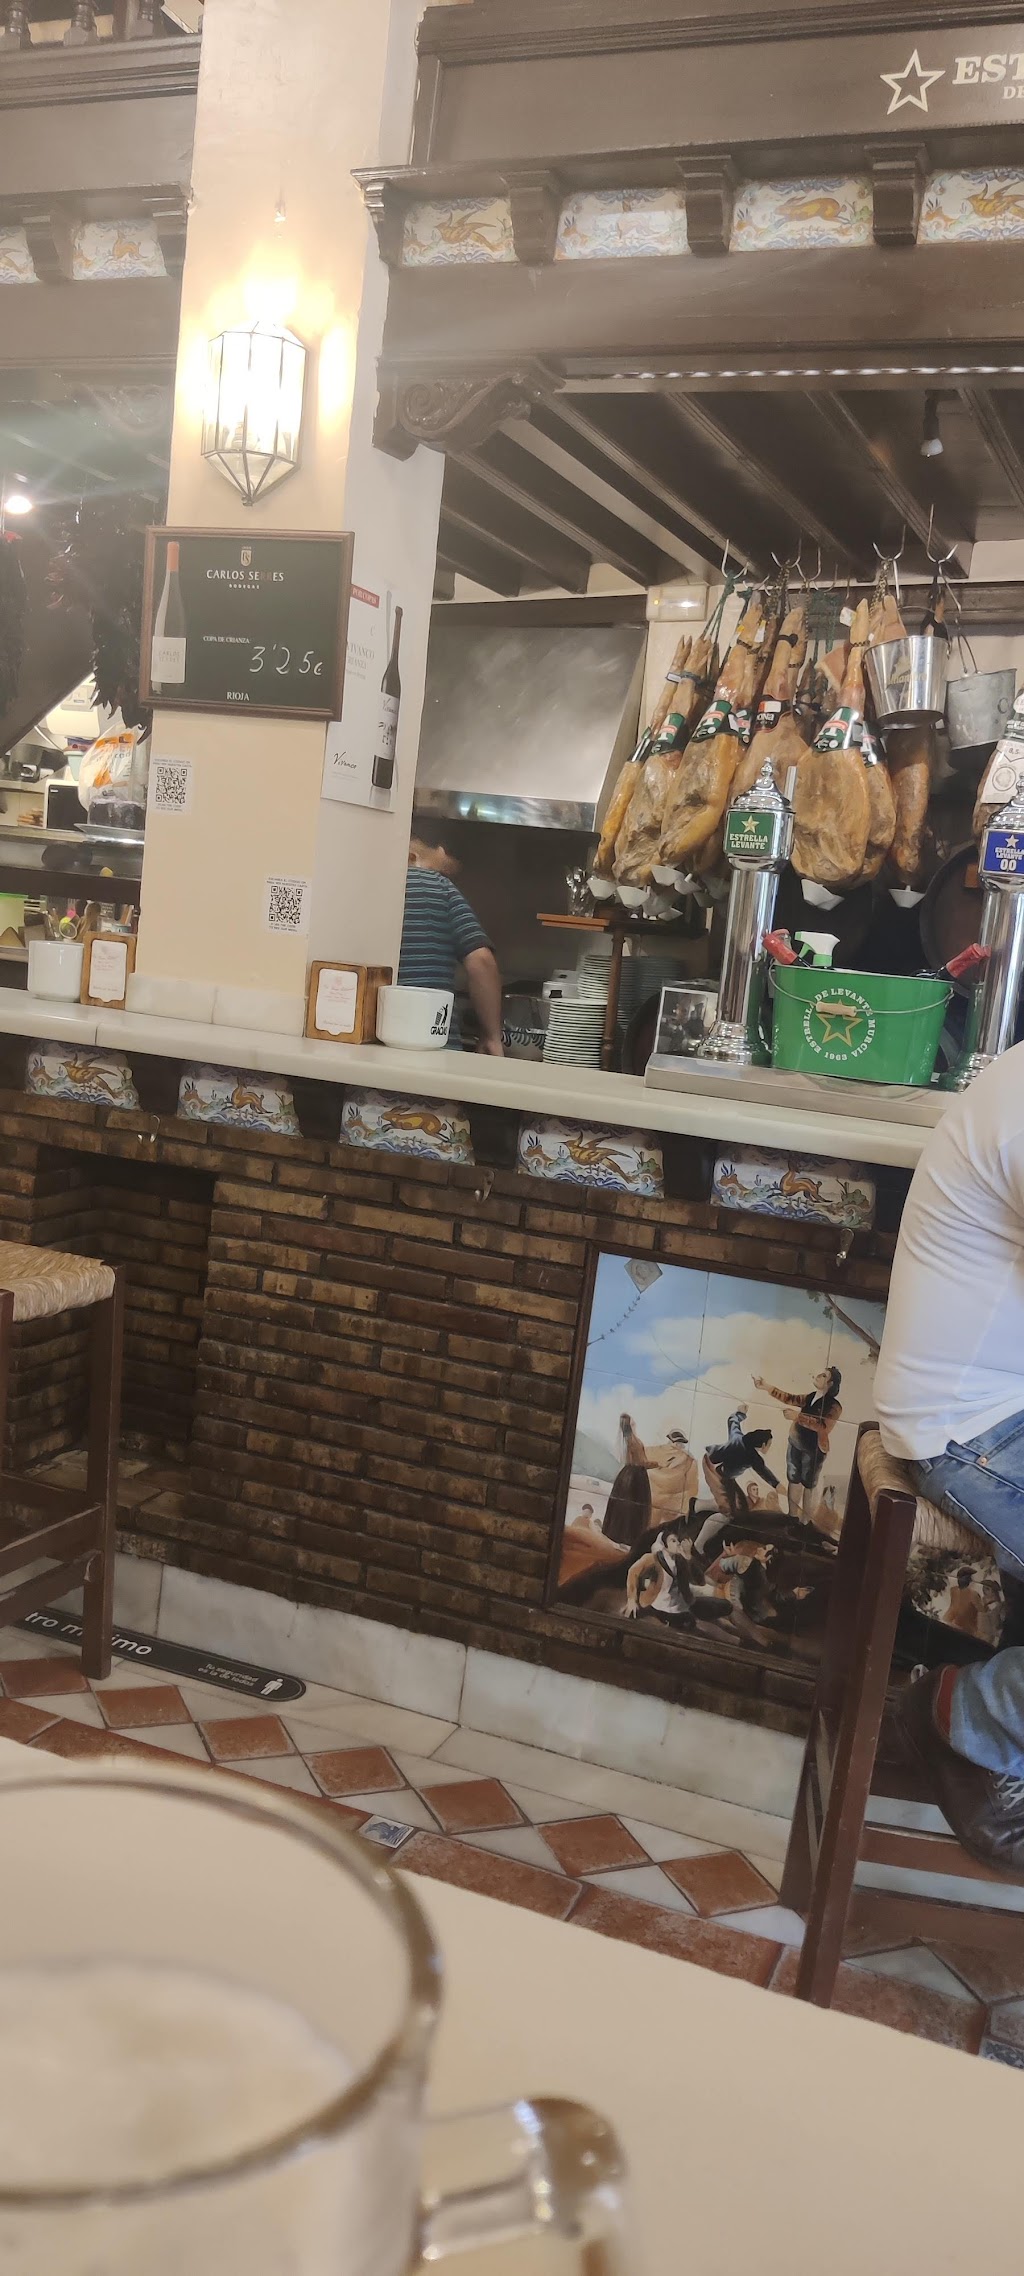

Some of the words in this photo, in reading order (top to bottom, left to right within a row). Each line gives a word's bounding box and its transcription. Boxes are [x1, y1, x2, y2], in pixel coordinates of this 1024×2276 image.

[206, 569, 245, 581] CARLOS
[203, 635, 217, 643] COPA
[225, 636, 250, 644] CRIANZA
[226, 691, 250, 701] RIOJA
[729, 833, 769, 843] ESTRELLA
[731, 840, 766, 850] LEVANTE
[814, 990, 829, 1002] DE
[850, 1019, 876, 1058] MURCIA
[24, 1611, 59, 1628] tro
